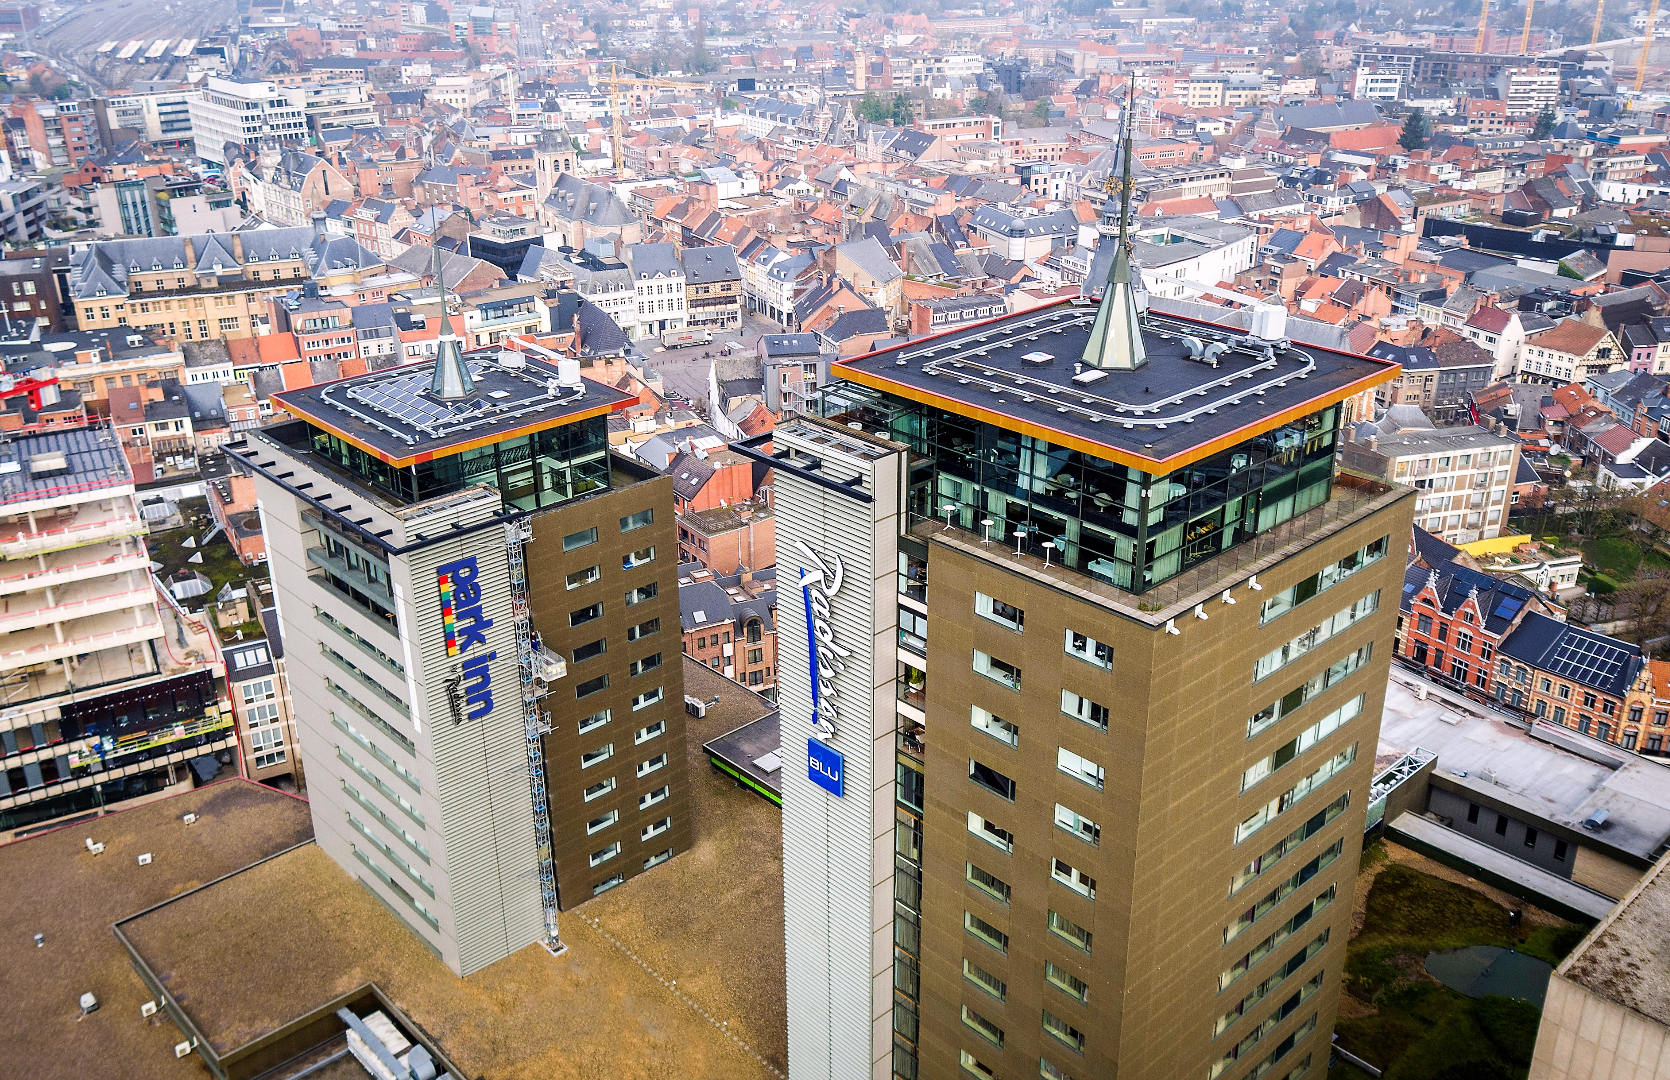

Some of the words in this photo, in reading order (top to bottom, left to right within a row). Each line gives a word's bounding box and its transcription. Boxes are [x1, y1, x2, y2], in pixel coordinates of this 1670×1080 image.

[437, 555, 494, 654] park
[795, 540, 852, 741] Radisson
[462, 650, 498, 721] inn
[809, 755, 839, 782] BLU
